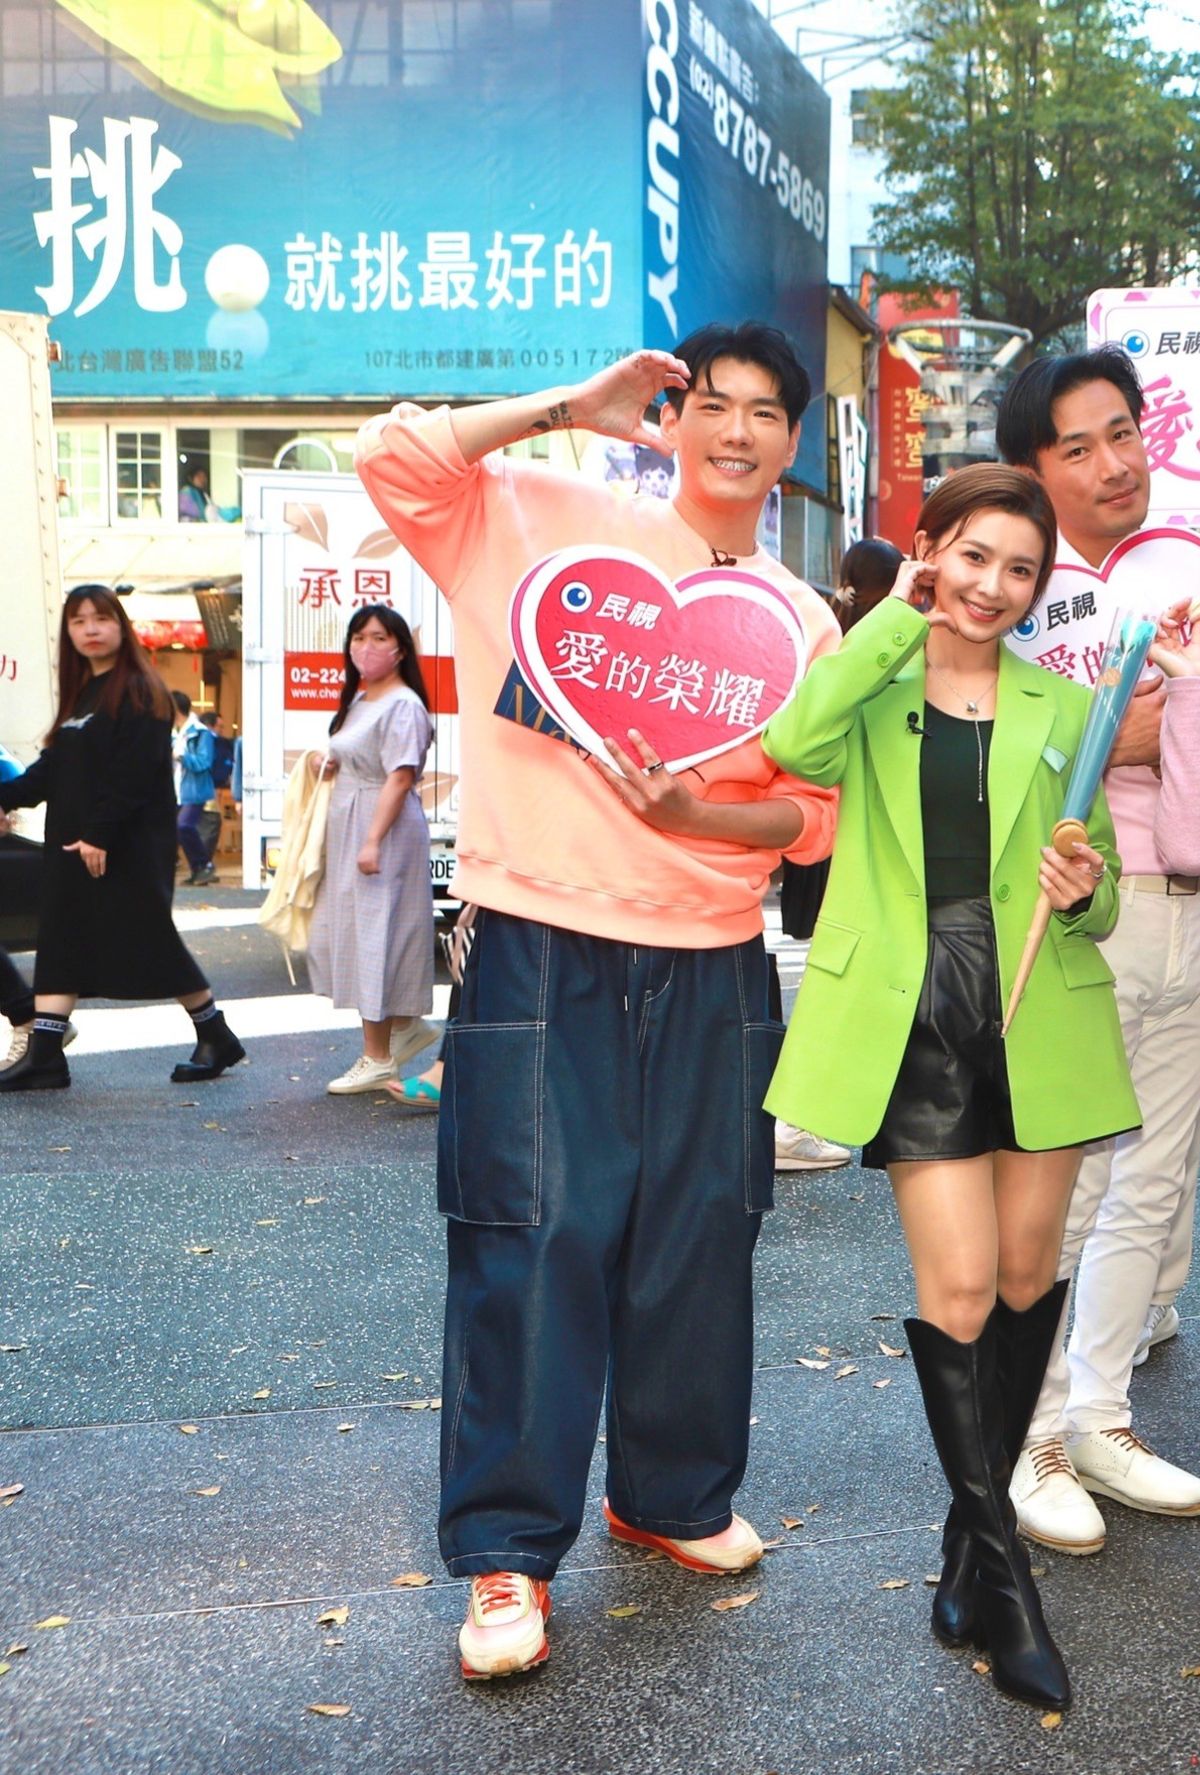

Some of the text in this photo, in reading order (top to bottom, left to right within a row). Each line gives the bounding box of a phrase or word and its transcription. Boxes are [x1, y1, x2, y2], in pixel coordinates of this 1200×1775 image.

[32, 114, 188, 319] 挑
[283, 227, 613, 313] 就挑最好的
[299, 567, 394, 609] 承恩
[596, 592, 663, 630] 民視
[1046, 590, 1098, 631] 民視
[550, 629, 766, 728] 愛的榮耀
